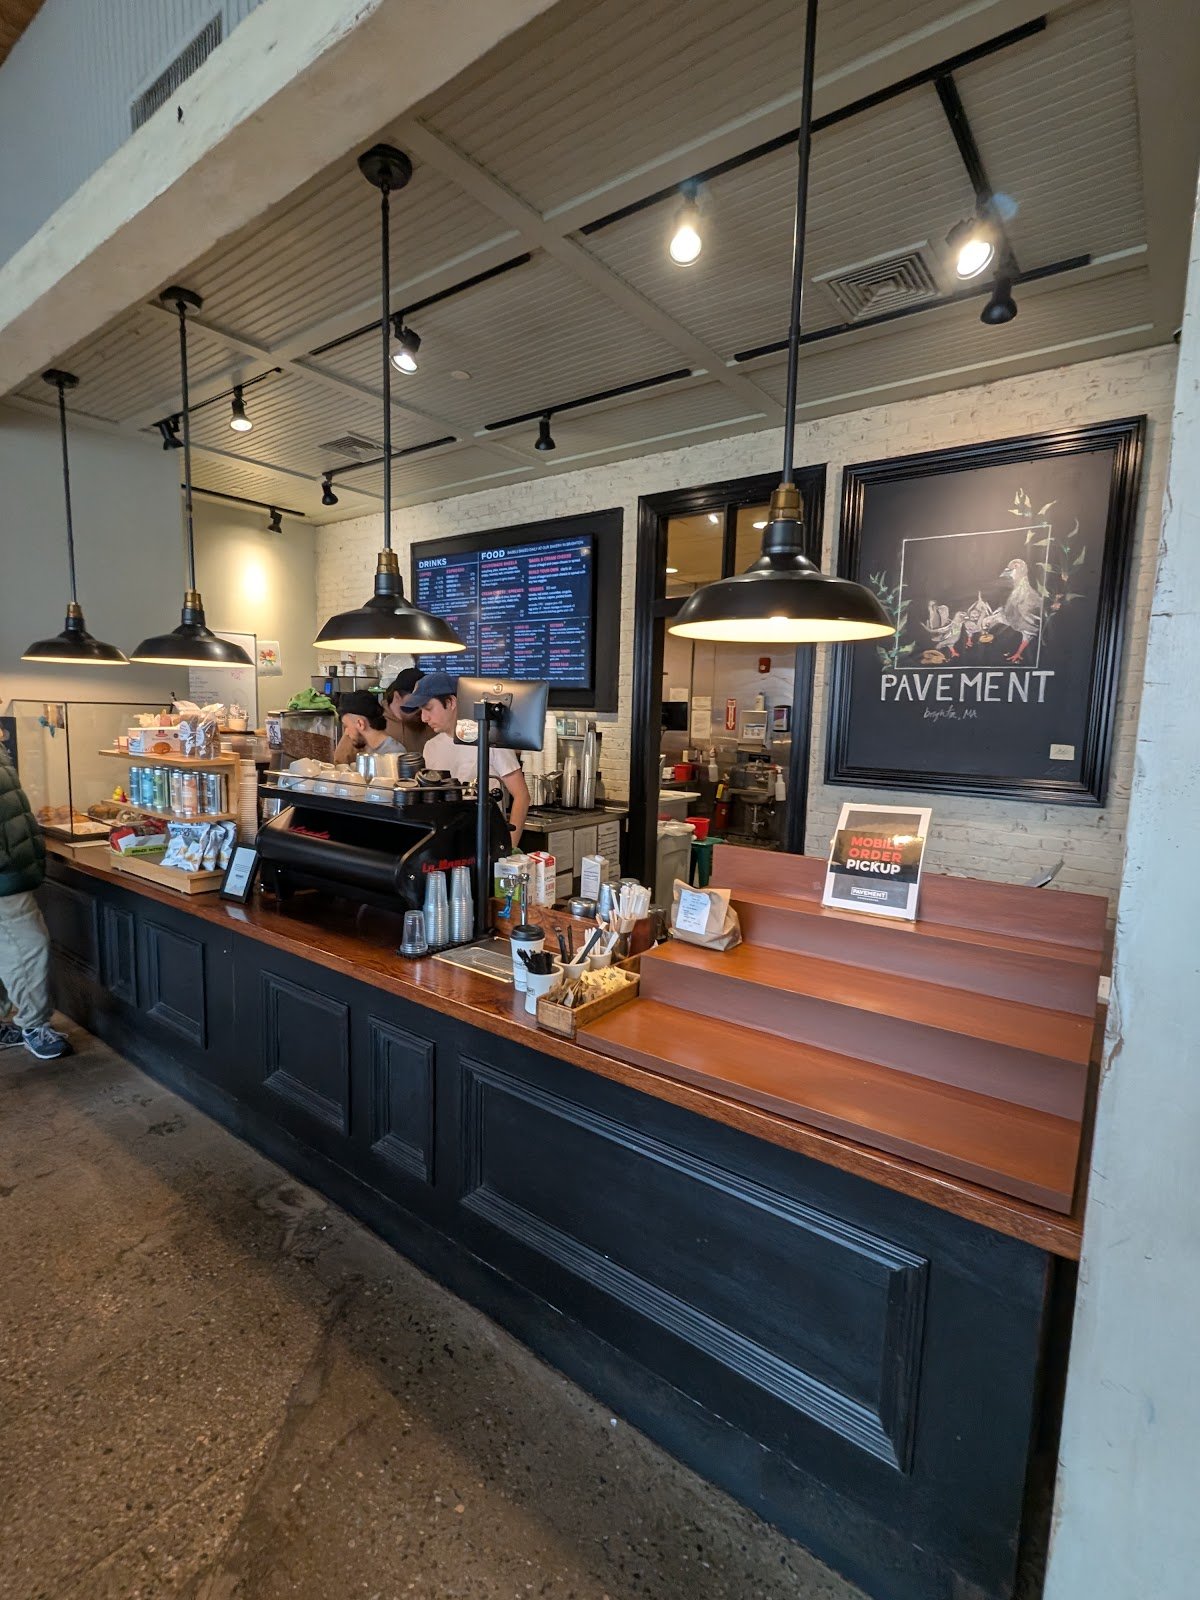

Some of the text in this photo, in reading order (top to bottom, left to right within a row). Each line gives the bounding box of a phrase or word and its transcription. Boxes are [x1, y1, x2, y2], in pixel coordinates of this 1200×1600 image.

[481, 549, 505, 560] FOOD
[418, 558, 447, 569] DRINKS
[880, 670, 1055, 703] PAVEMENT
[848, 847, 903, 863] ORDER
[846, 858, 901, 875] PICKUP
[852, 888, 886, 899] PAVEMENT
